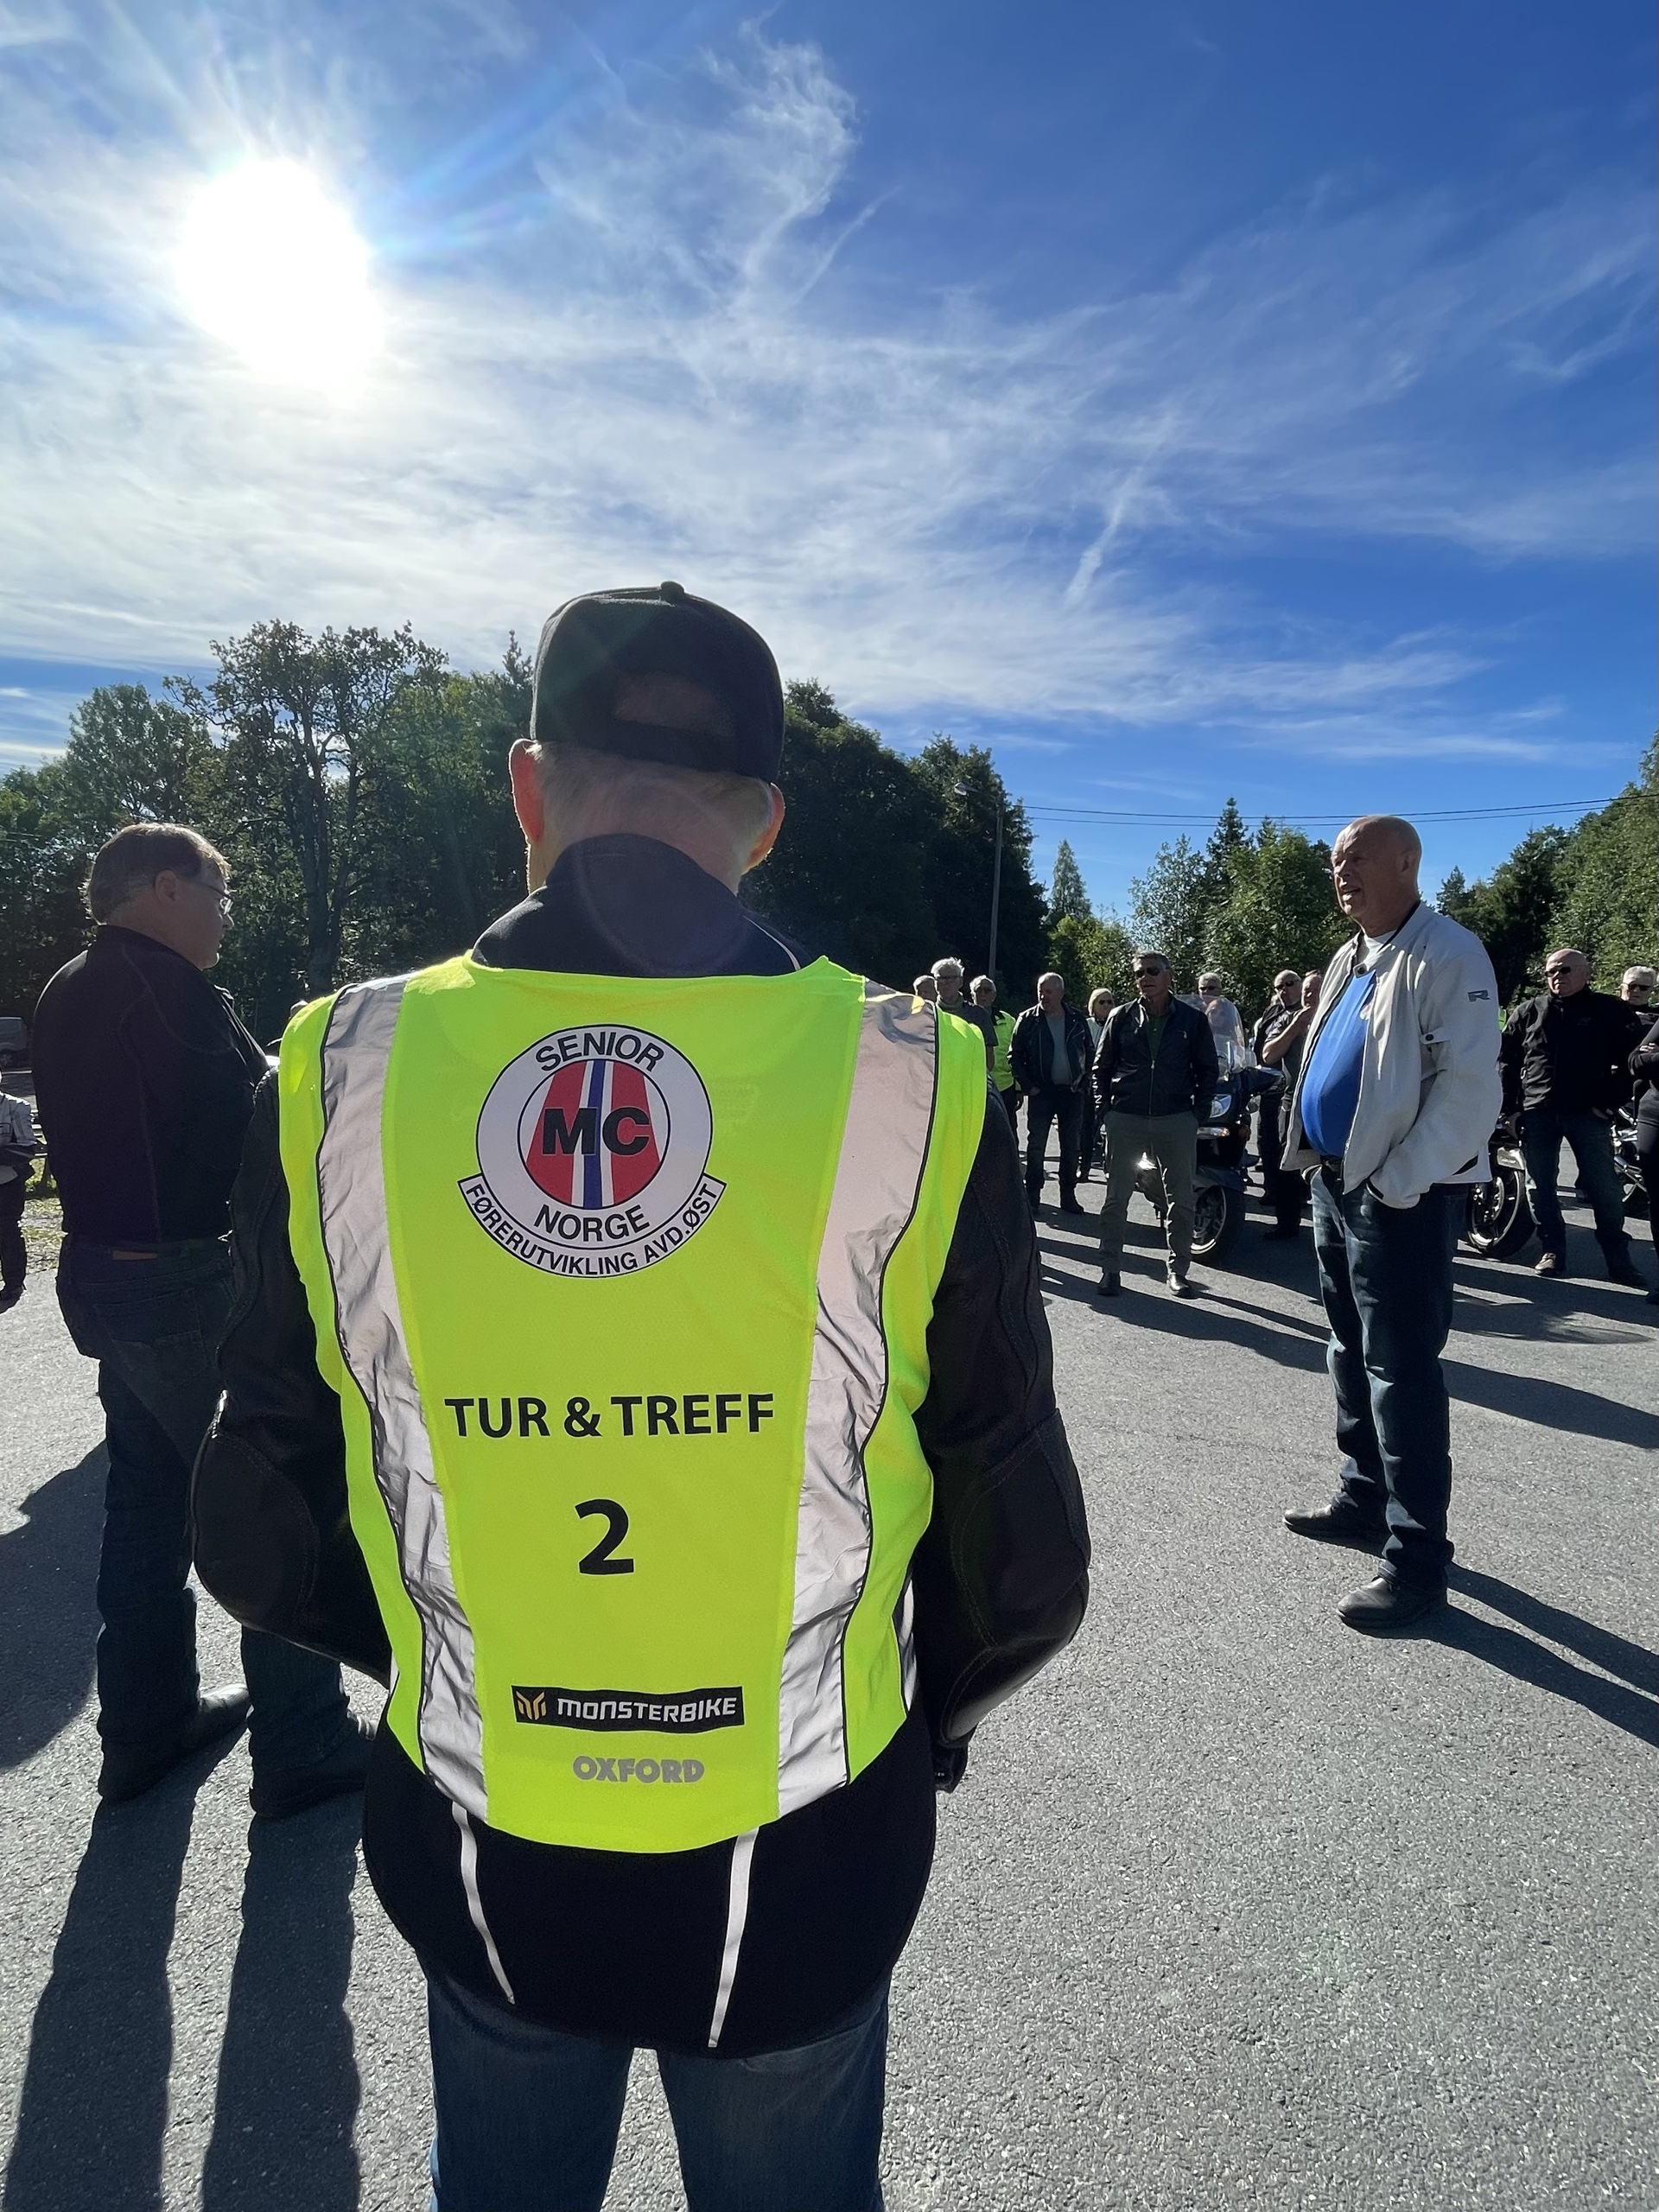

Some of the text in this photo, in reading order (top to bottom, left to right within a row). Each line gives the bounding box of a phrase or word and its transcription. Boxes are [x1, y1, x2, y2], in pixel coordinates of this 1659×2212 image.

[535, 1031, 665, 1072] SENIOR
[542, 1107, 650, 1156] MC
[466, 1183, 639, 1275] FØRERUTVIKLING
[533, 1204, 651, 1243] NORGE
[444, 1393, 774, 1438] TUR & TREFF
[575, 1498, 635, 1575] 2
[557, 1696, 737, 1723] MONSTERBIKE
[573, 1755, 705, 1783] OXFORD
